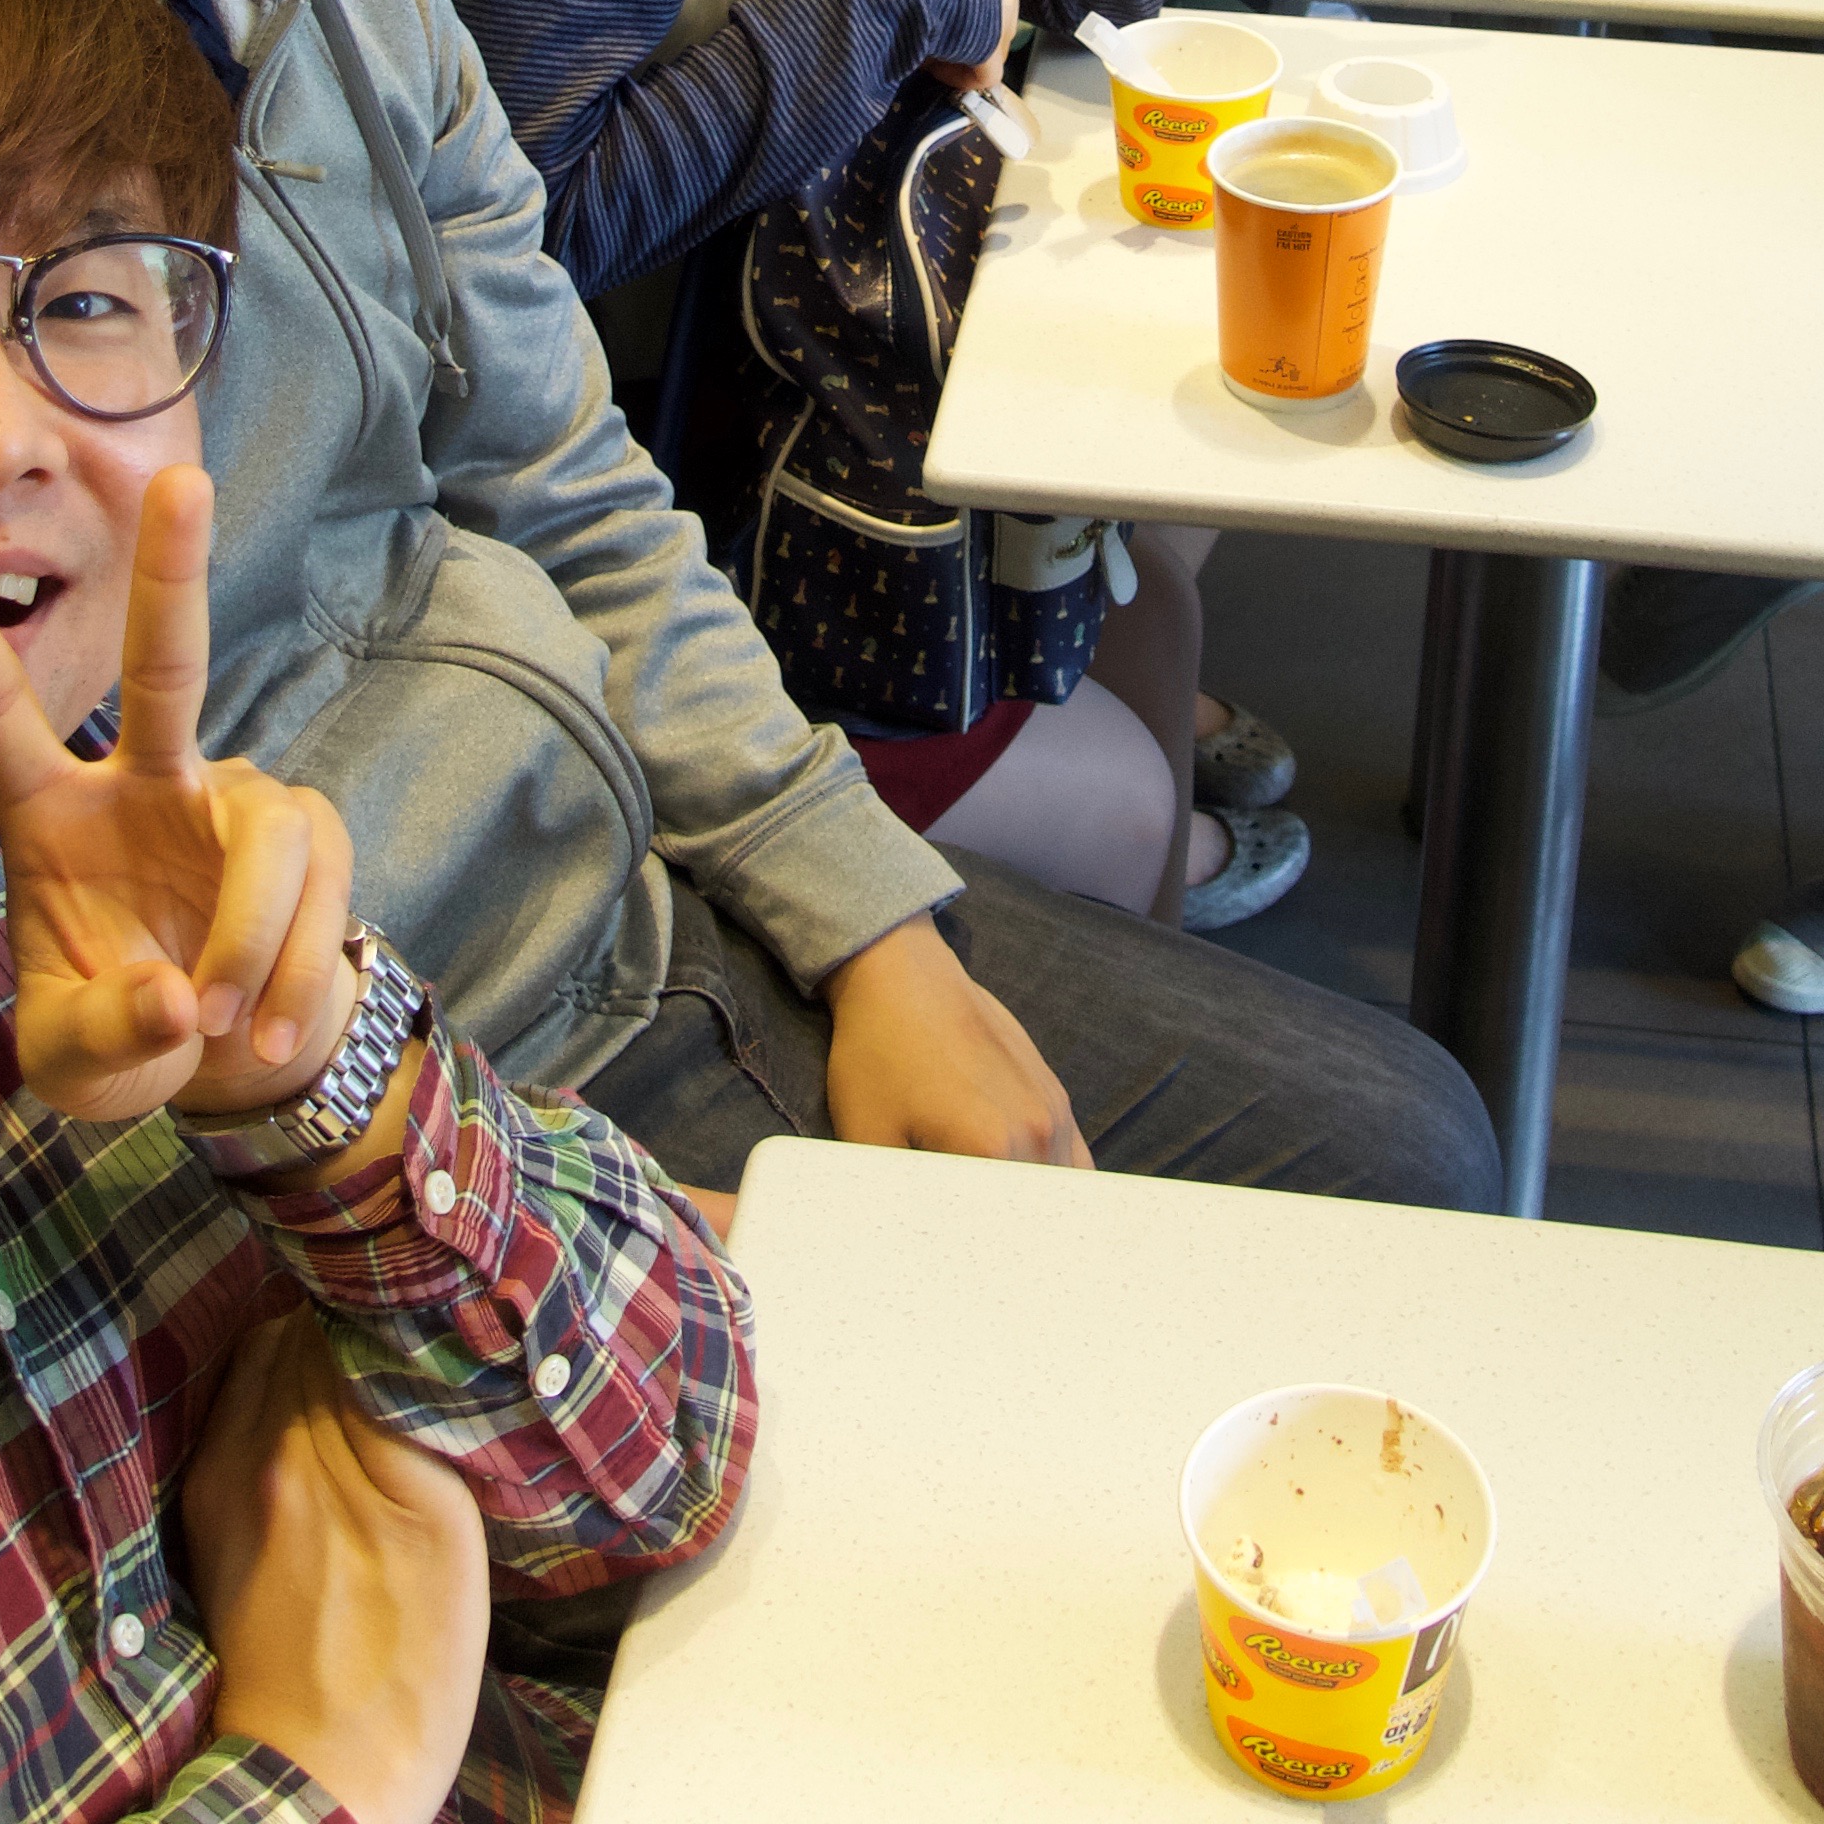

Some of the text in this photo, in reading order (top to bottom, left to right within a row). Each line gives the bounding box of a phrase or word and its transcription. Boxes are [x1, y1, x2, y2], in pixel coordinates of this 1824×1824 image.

[1143, 109, 1207, 133] Reese's
[1142, 189, 1205, 213] Reese's
[1244, 1633, 1361, 1678] Reese's
[1240, 1735, 1352, 1778] Reese's
